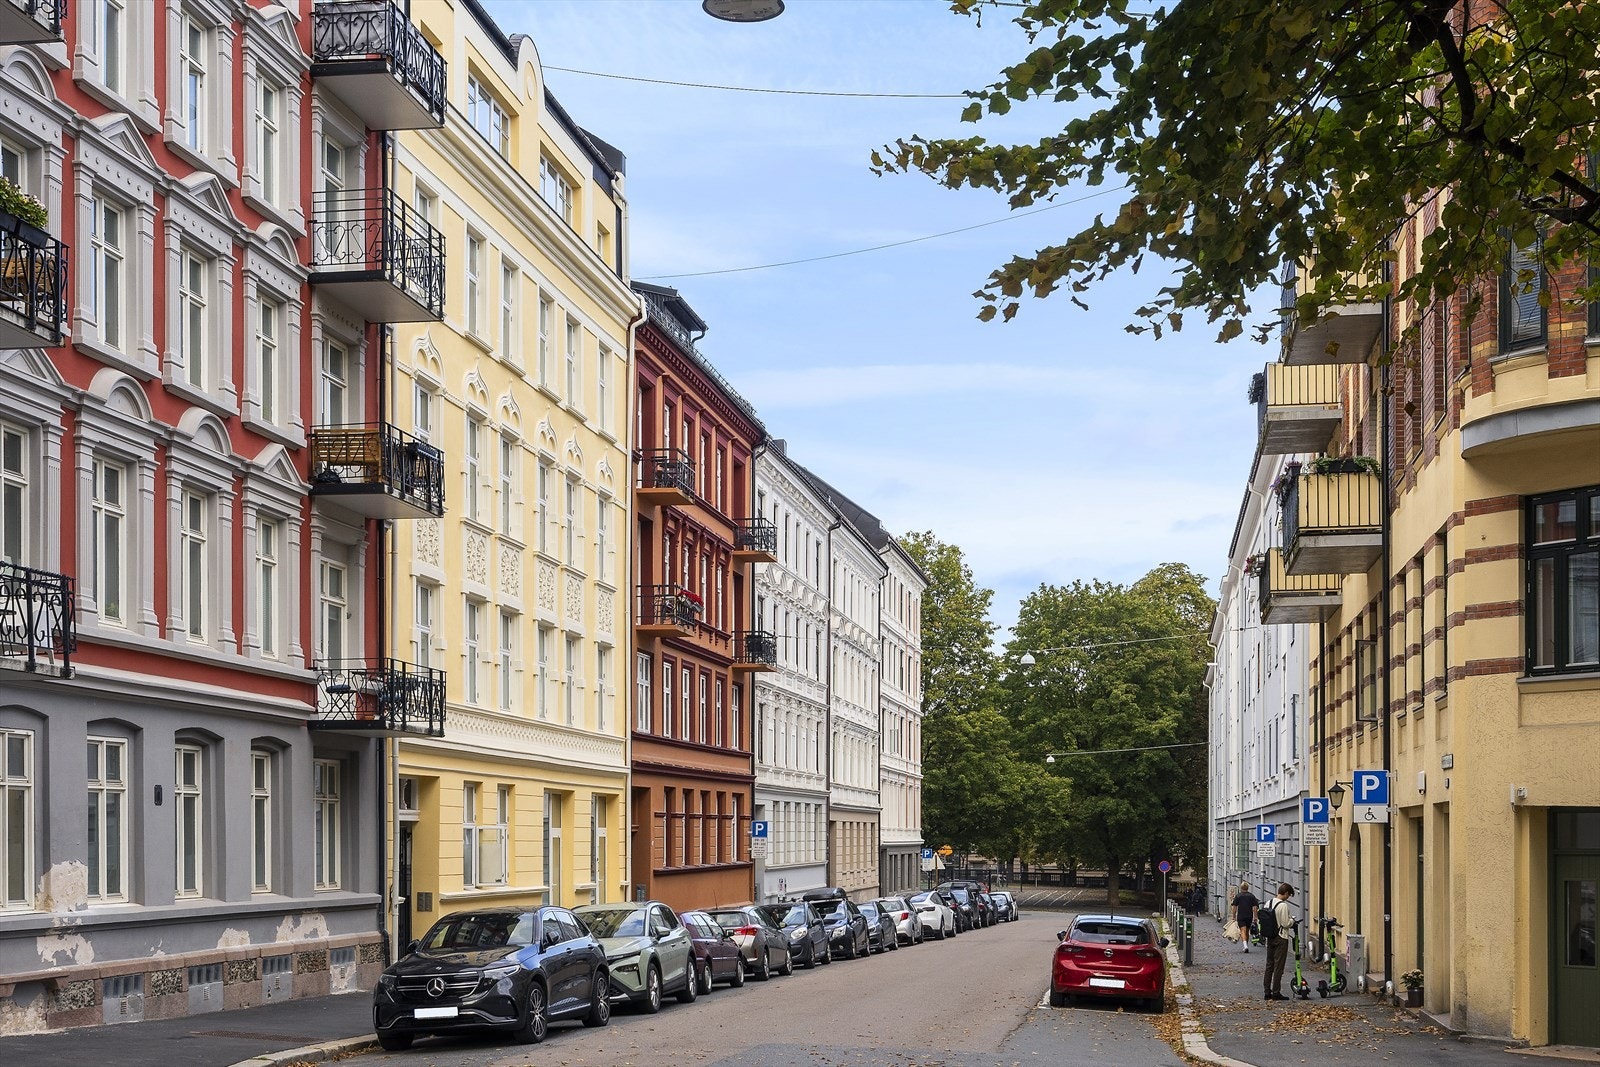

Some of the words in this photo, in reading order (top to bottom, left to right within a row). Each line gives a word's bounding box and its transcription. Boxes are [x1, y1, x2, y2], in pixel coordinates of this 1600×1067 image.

[1361, 774, 1380, 800] P
[1309, 801, 1323, 820] P
[755, 822, 764, 836] P
[1261, 826, 1271, 840] P
